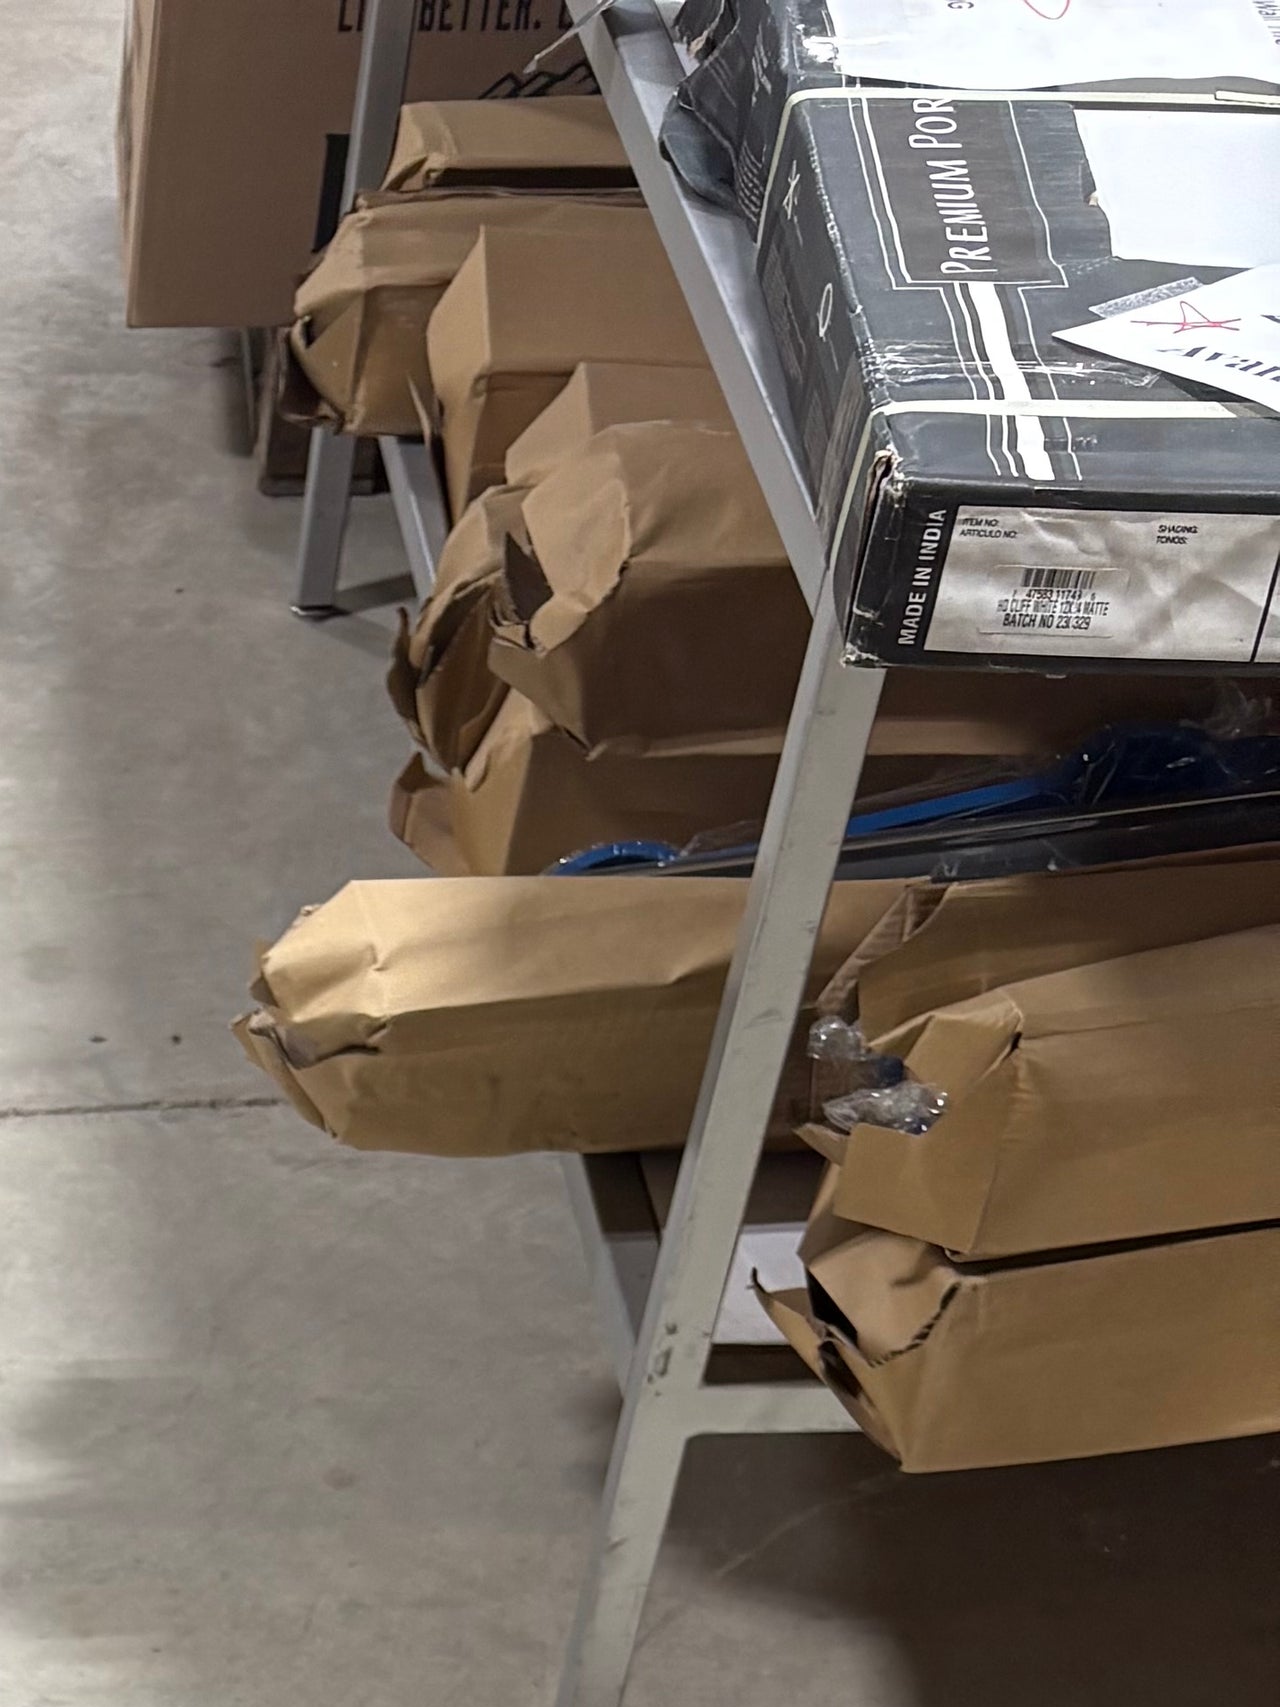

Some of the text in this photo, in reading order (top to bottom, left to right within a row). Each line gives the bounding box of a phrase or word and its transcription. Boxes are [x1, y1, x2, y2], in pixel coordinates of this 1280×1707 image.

[925, 158, 997, 274] PREMIUM
[896, 508, 948, 646] MADE IN INDIA
[1002, 613, 1037, 628] BATCH
[1038, 614, 1055, 628] NO
